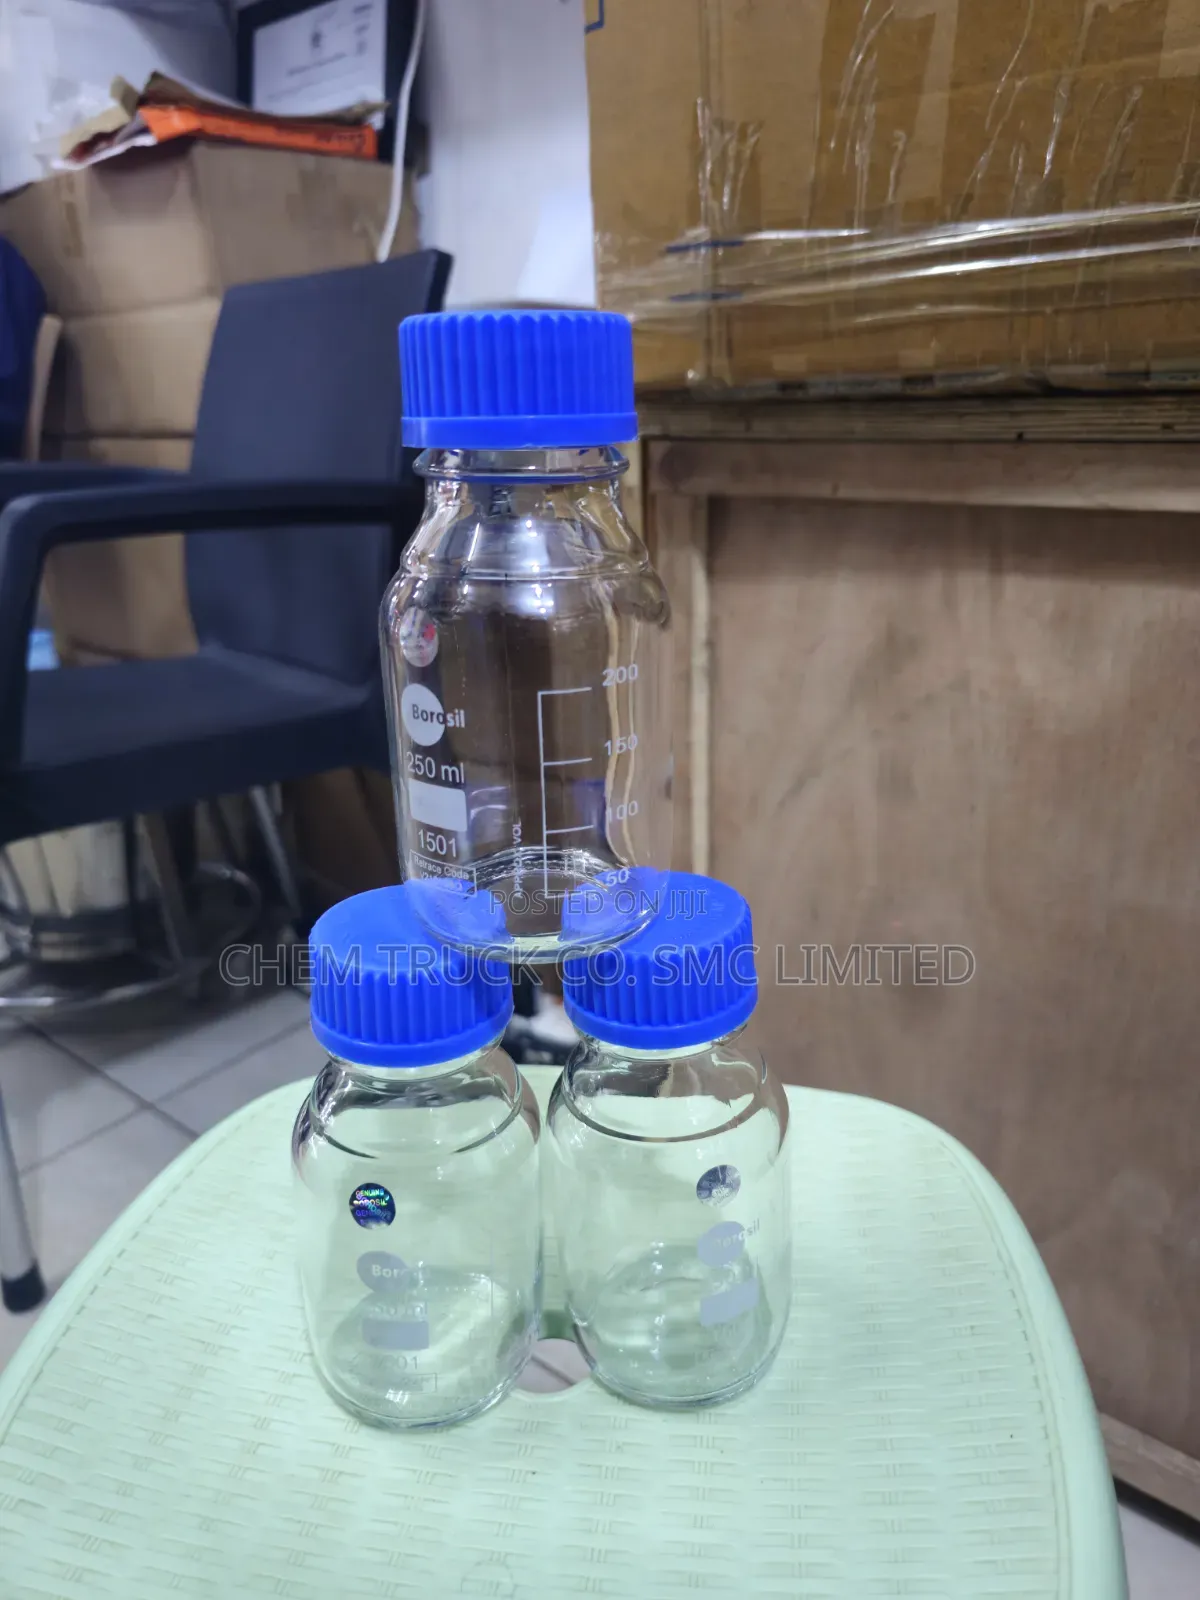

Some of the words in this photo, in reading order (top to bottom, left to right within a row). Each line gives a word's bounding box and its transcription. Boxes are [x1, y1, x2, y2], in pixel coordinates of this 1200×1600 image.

[602, 663, 639, 687] 200
[412, 703, 466, 729] Borosil
[604, 733, 638, 757] 150
[406, 751, 436, 779] 250
[441, 762, 465, 784] ml
[606, 800, 639, 825] 100
[418, 828, 457, 858] 1501
[444, 866, 470, 881] Code
[605, 867, 631, 888] 50
